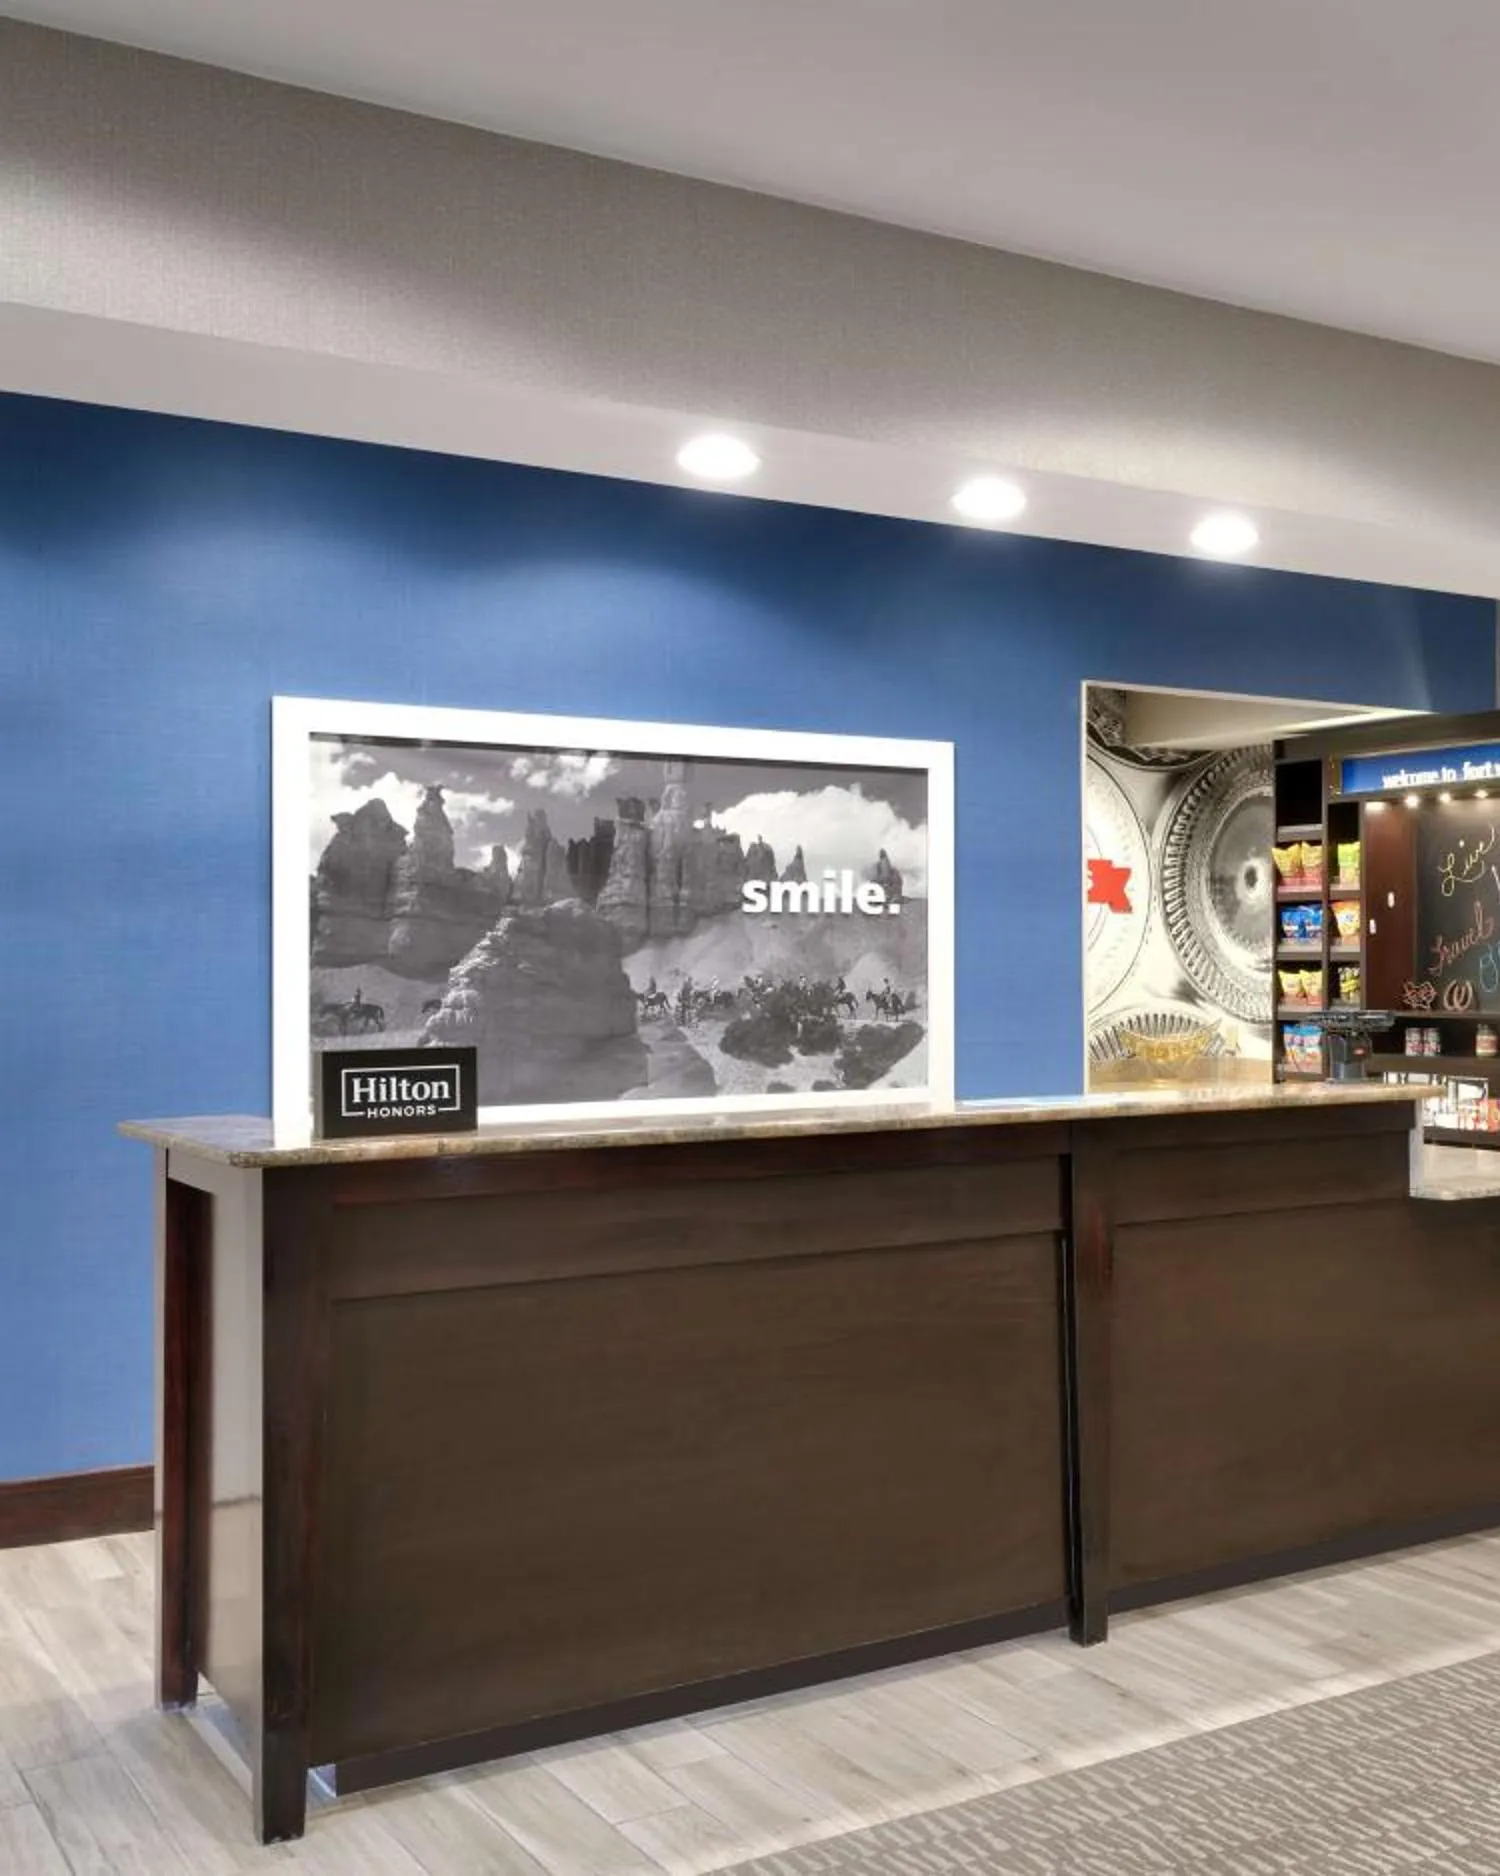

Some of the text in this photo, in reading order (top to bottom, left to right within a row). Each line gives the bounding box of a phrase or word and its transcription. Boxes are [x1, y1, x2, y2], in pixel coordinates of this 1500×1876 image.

[1382, 769, 1439, 788] welcome
[1441, 766, 1457, 783] to
[1462, 761, 1493, 780] fort
[741, 869, 901, 915] smile.
[352, 1073, 451, 1104] Hilton
[367, 1104, 437, 1119] HONORS
